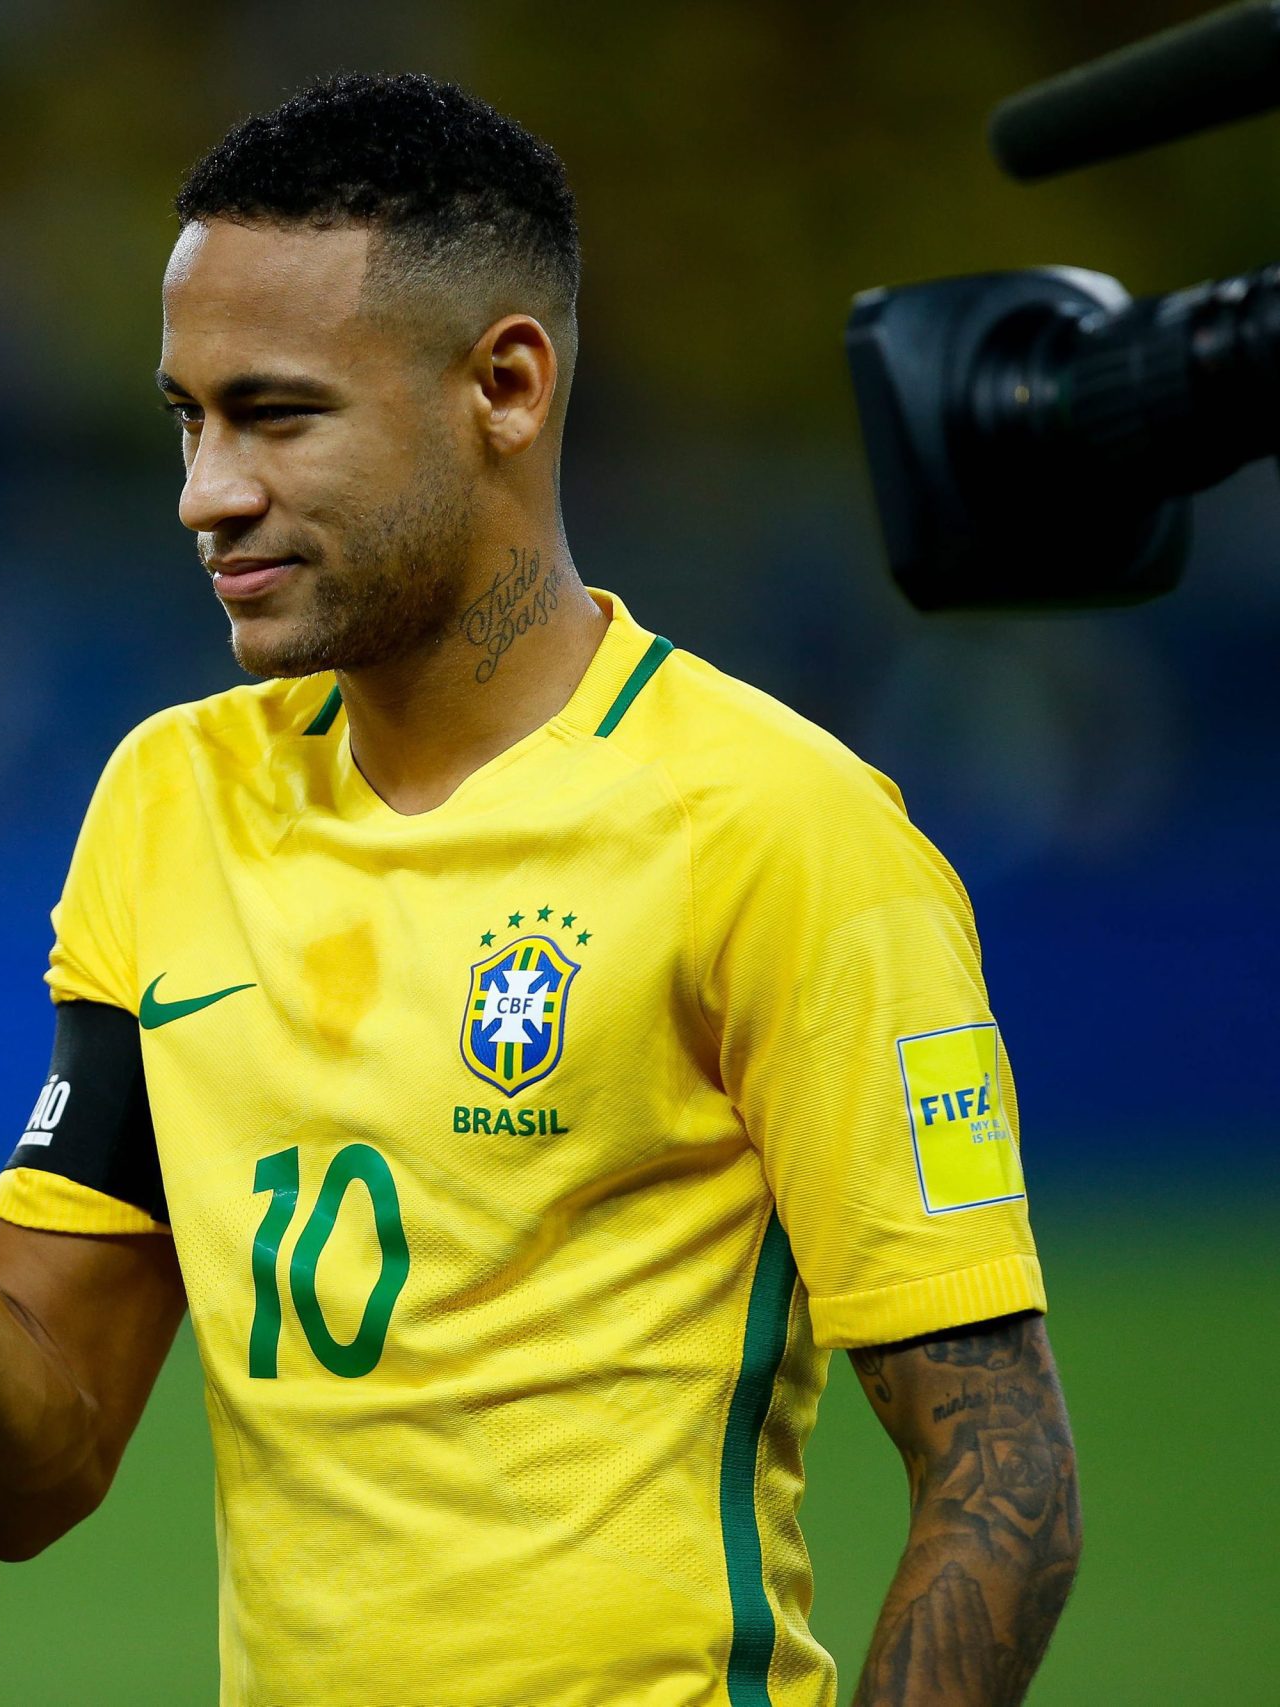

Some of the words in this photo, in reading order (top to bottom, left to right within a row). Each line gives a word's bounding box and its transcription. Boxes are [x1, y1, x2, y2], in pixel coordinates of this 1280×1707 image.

[496, 996, 534, 1015] CBF
[453, 1105, 569, 1137] BRASIL
[249, 1143, 410, 1379] 10
